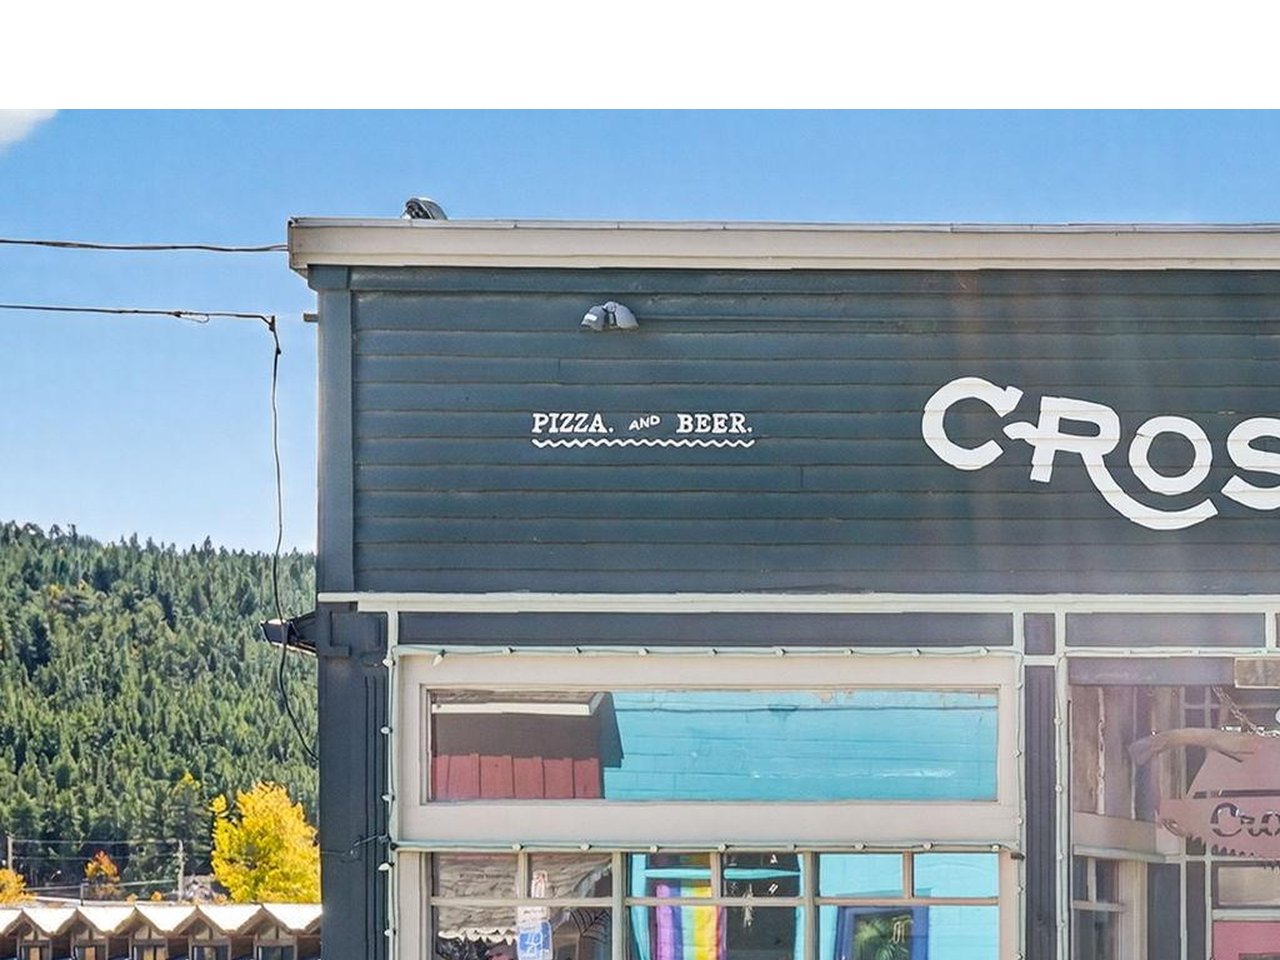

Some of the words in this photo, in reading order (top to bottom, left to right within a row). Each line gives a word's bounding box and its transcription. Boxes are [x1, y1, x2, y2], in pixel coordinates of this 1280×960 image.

[531, 412, 614, 434] PIZZA.
[628, 415, 661, 431] AND
[676, 412, 753, 434] BEER.
